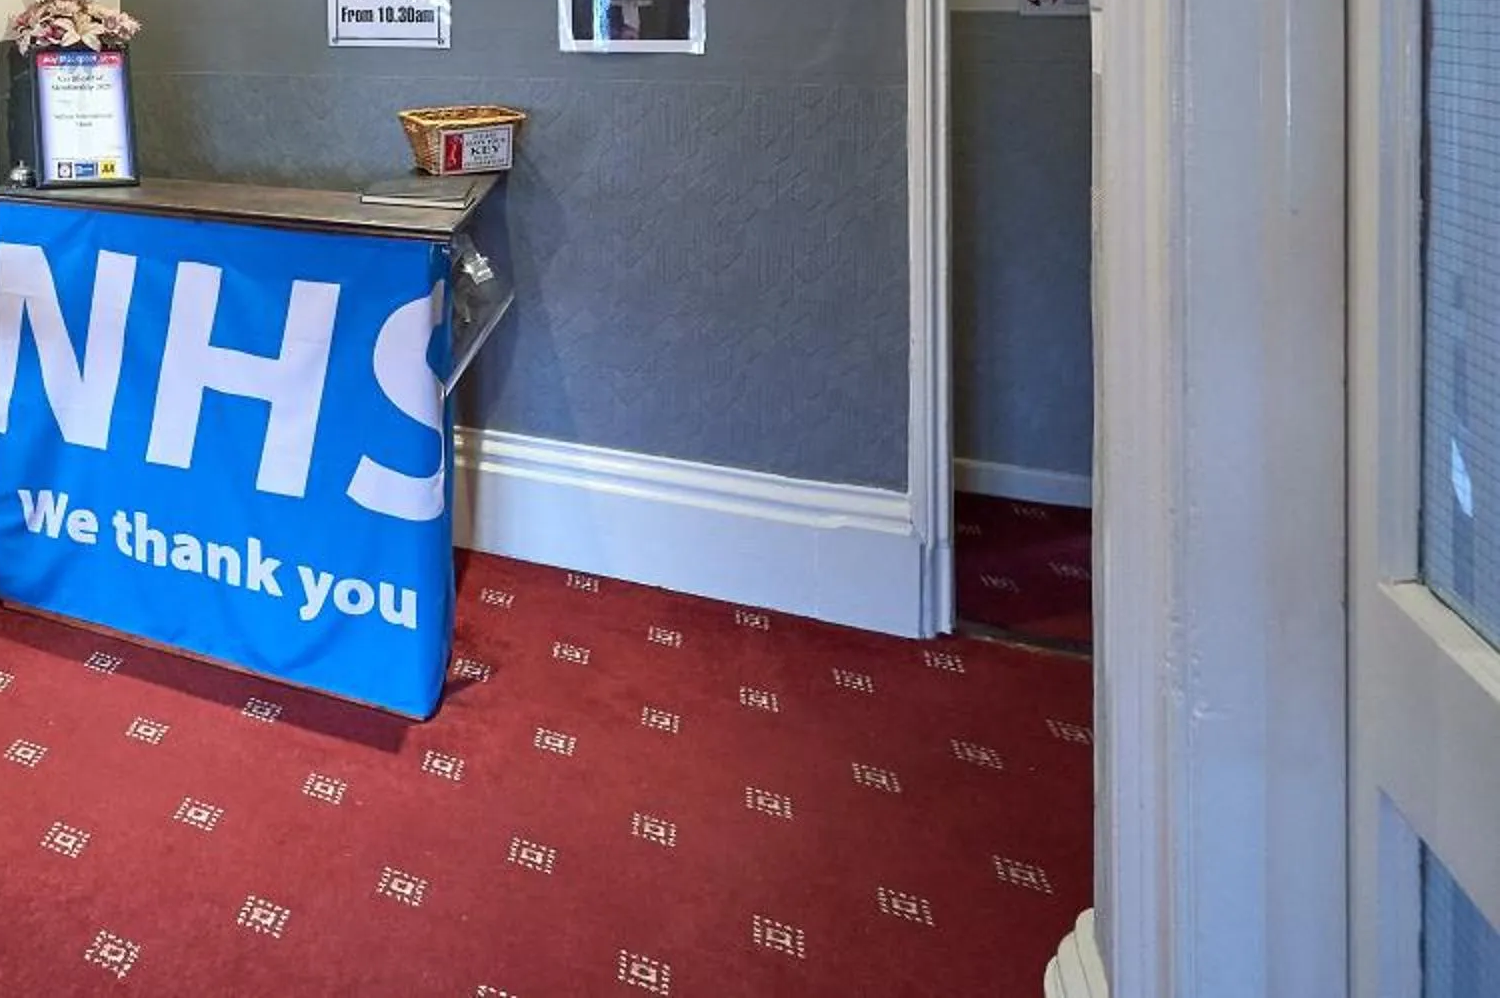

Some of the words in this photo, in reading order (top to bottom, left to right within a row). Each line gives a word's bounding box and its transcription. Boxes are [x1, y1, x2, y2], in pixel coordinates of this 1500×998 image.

[341, 6, 375, 23] From
[378, 6, 436, 23] 10.30am
[470, 144, 501, 156] KEY
[17, 489, 99, 545] We
[112, 510, 283, 597] thank
[297, 565, 418, 630] you
